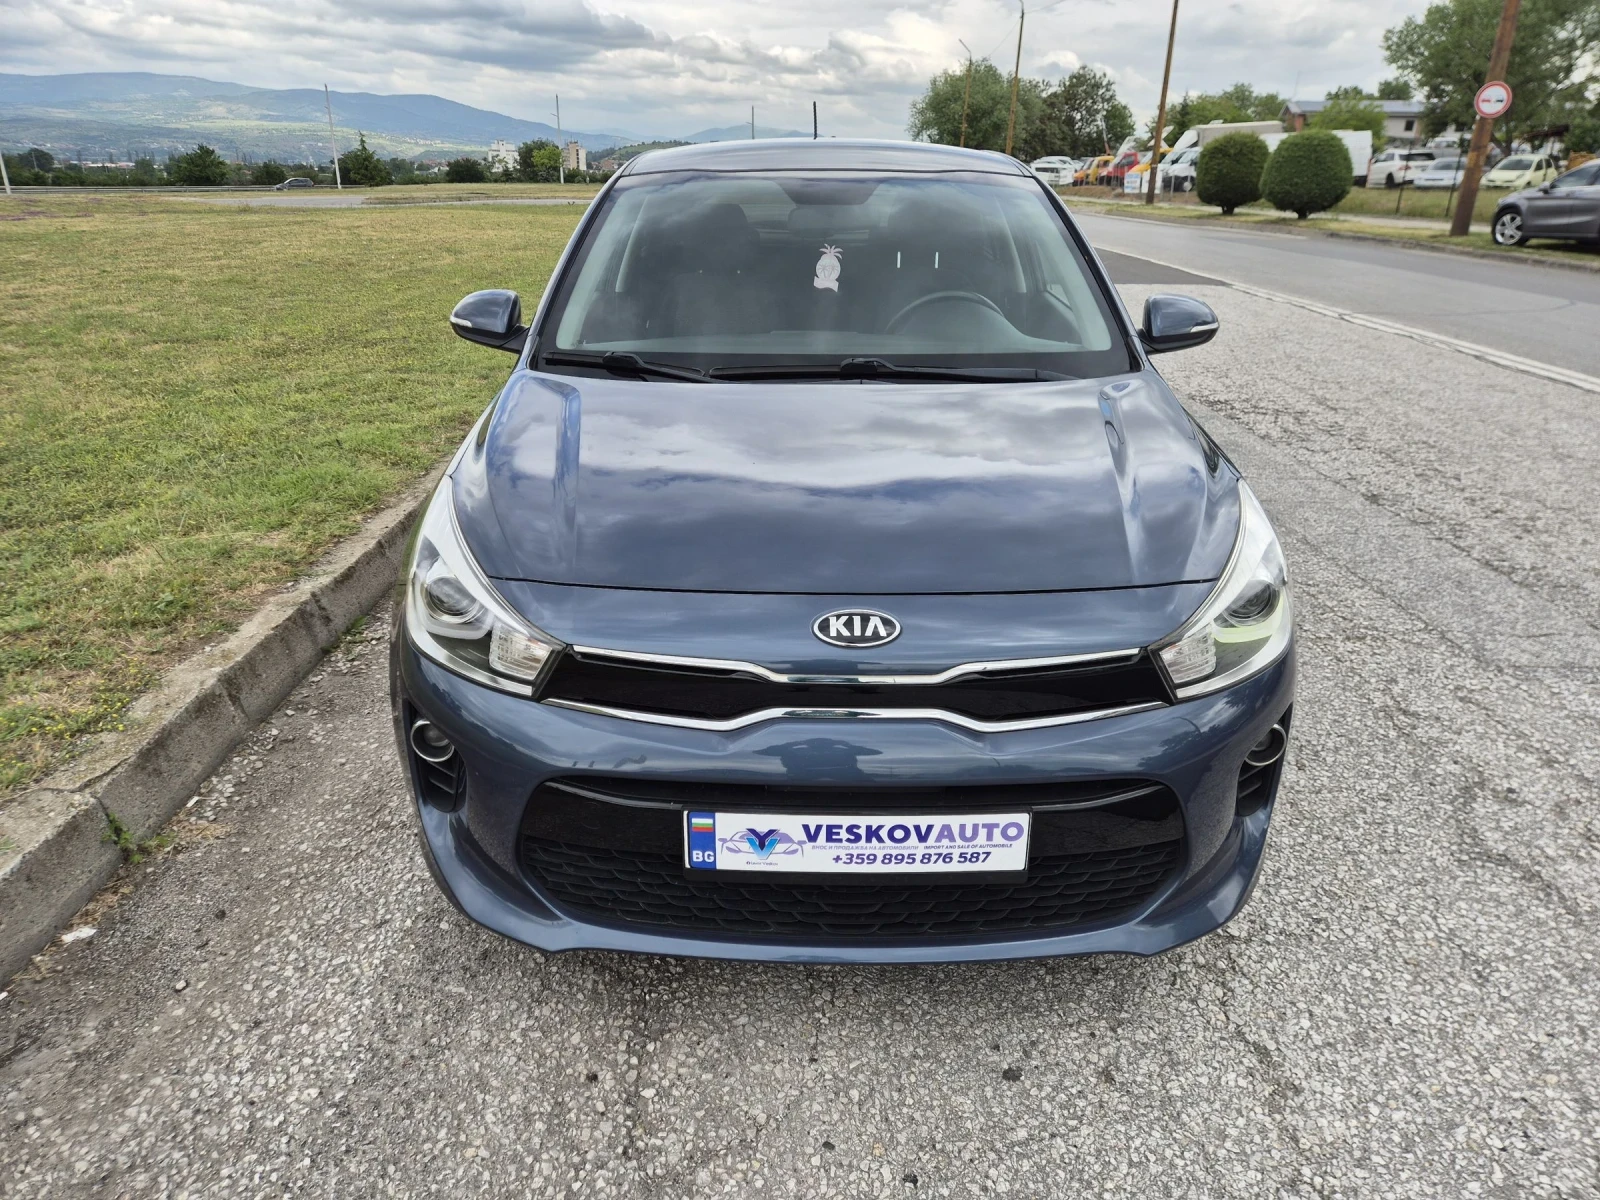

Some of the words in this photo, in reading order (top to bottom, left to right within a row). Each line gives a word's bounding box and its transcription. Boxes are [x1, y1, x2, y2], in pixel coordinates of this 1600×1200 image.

[828, 615, 887, 637] KIA
[801, 822, 1025, 844] VESKOVAUTO
[692, 850, 715, 862] BG
[832, 853, 878, 865] +359
[881, 853, 917, 865] 895
[919, 852, 954, 865] 876
[957, 851, 992, 864] 587
